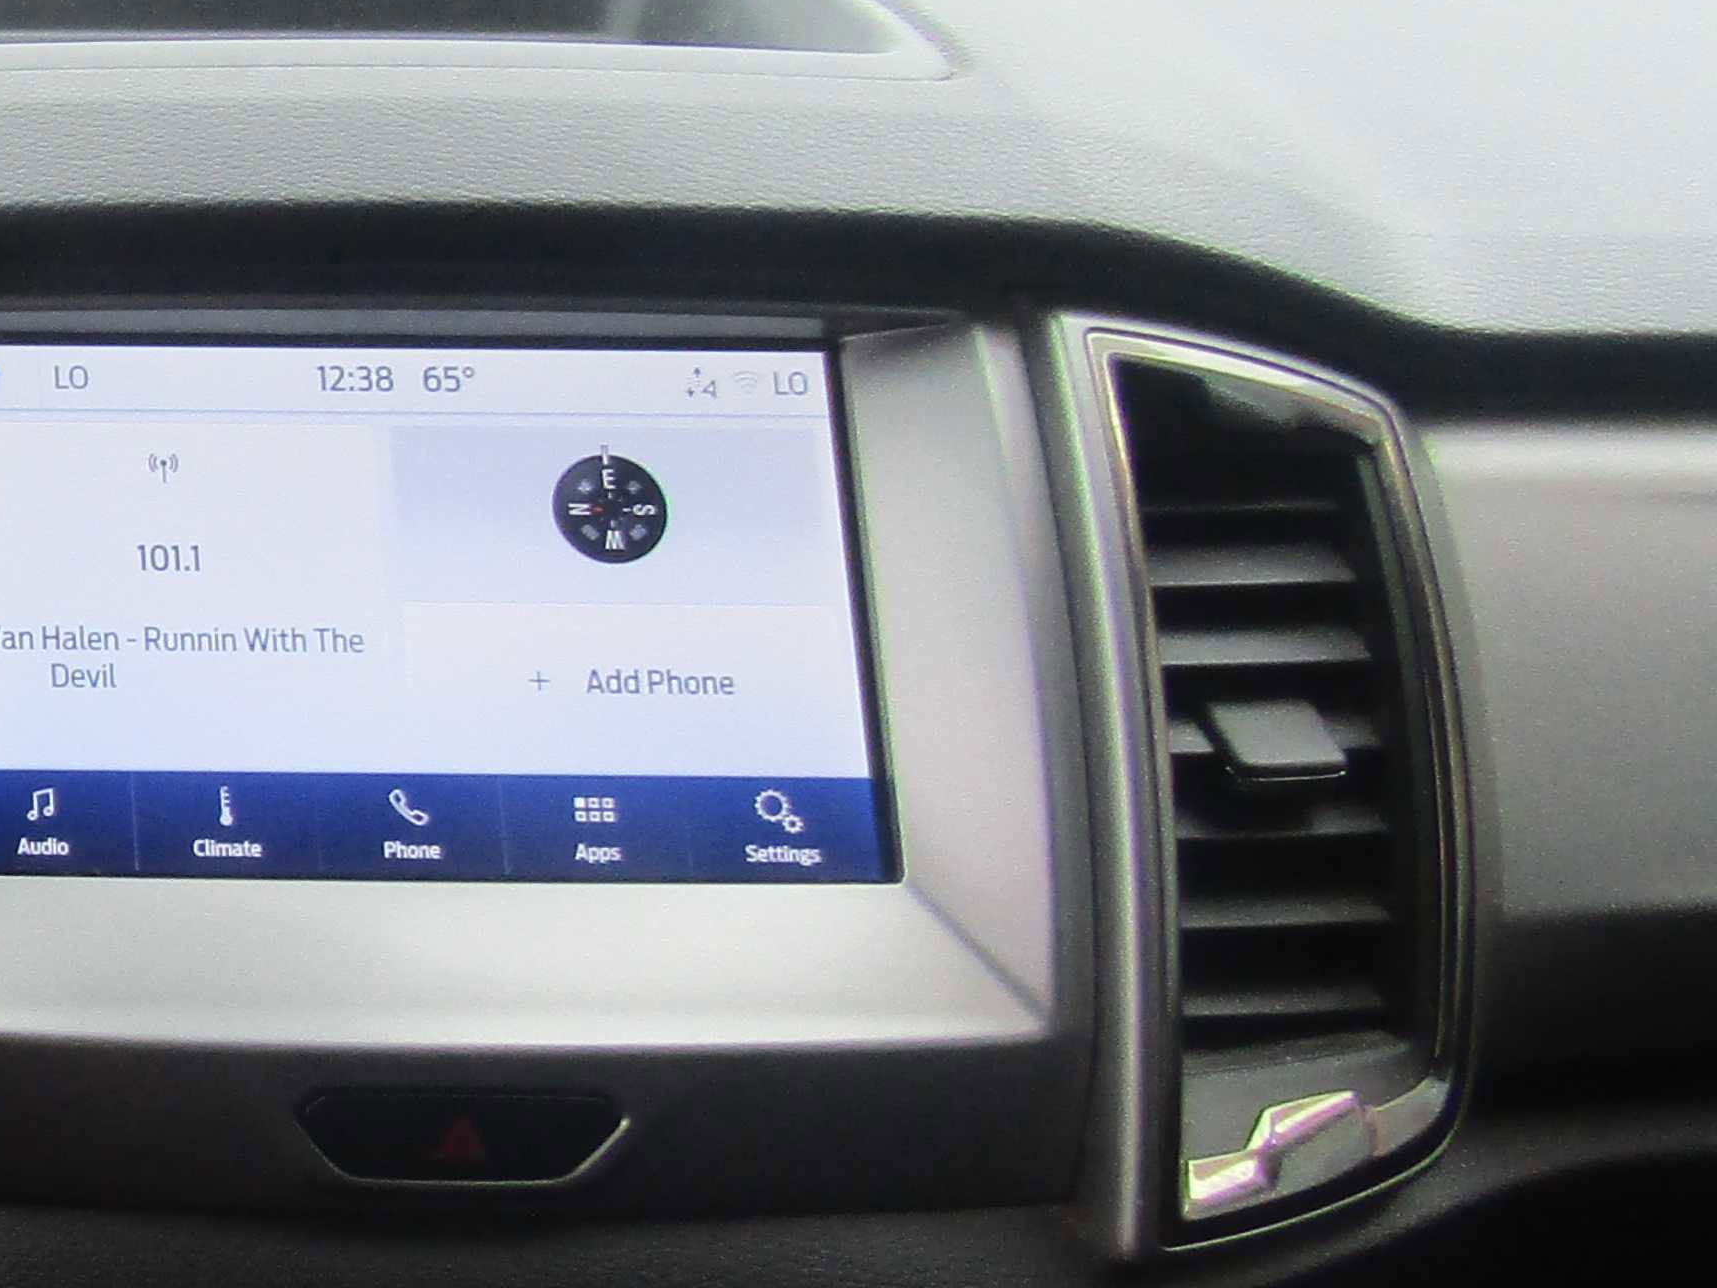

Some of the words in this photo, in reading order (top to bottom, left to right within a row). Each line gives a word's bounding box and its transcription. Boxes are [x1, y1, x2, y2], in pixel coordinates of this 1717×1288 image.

[53, 365, 90, 391] LO
[317, 365, 395, 393] 12:38
[422, 365, 475, 393] 65°
[773, 371, 809, 397] LO
[136, 544, 202, 573] 101.1
[41, 625, 119, 653] Halen
[143, 626, 237, 653] Runnin
[245, 626, 307, 654] With
[314, 627, 365, 654] The
[50, 663, 117, 690] Devil
[586, 669, 640, 695] Add
[647, 669, 735, 696] Phone
[17, 837, 69, 856] Audio
[193, 838, 263, 858] Climate
[383, 840, 441, 860] Phone
[575, 843, 621, 863] Apps
[745, 844, 822, 866] Settings
